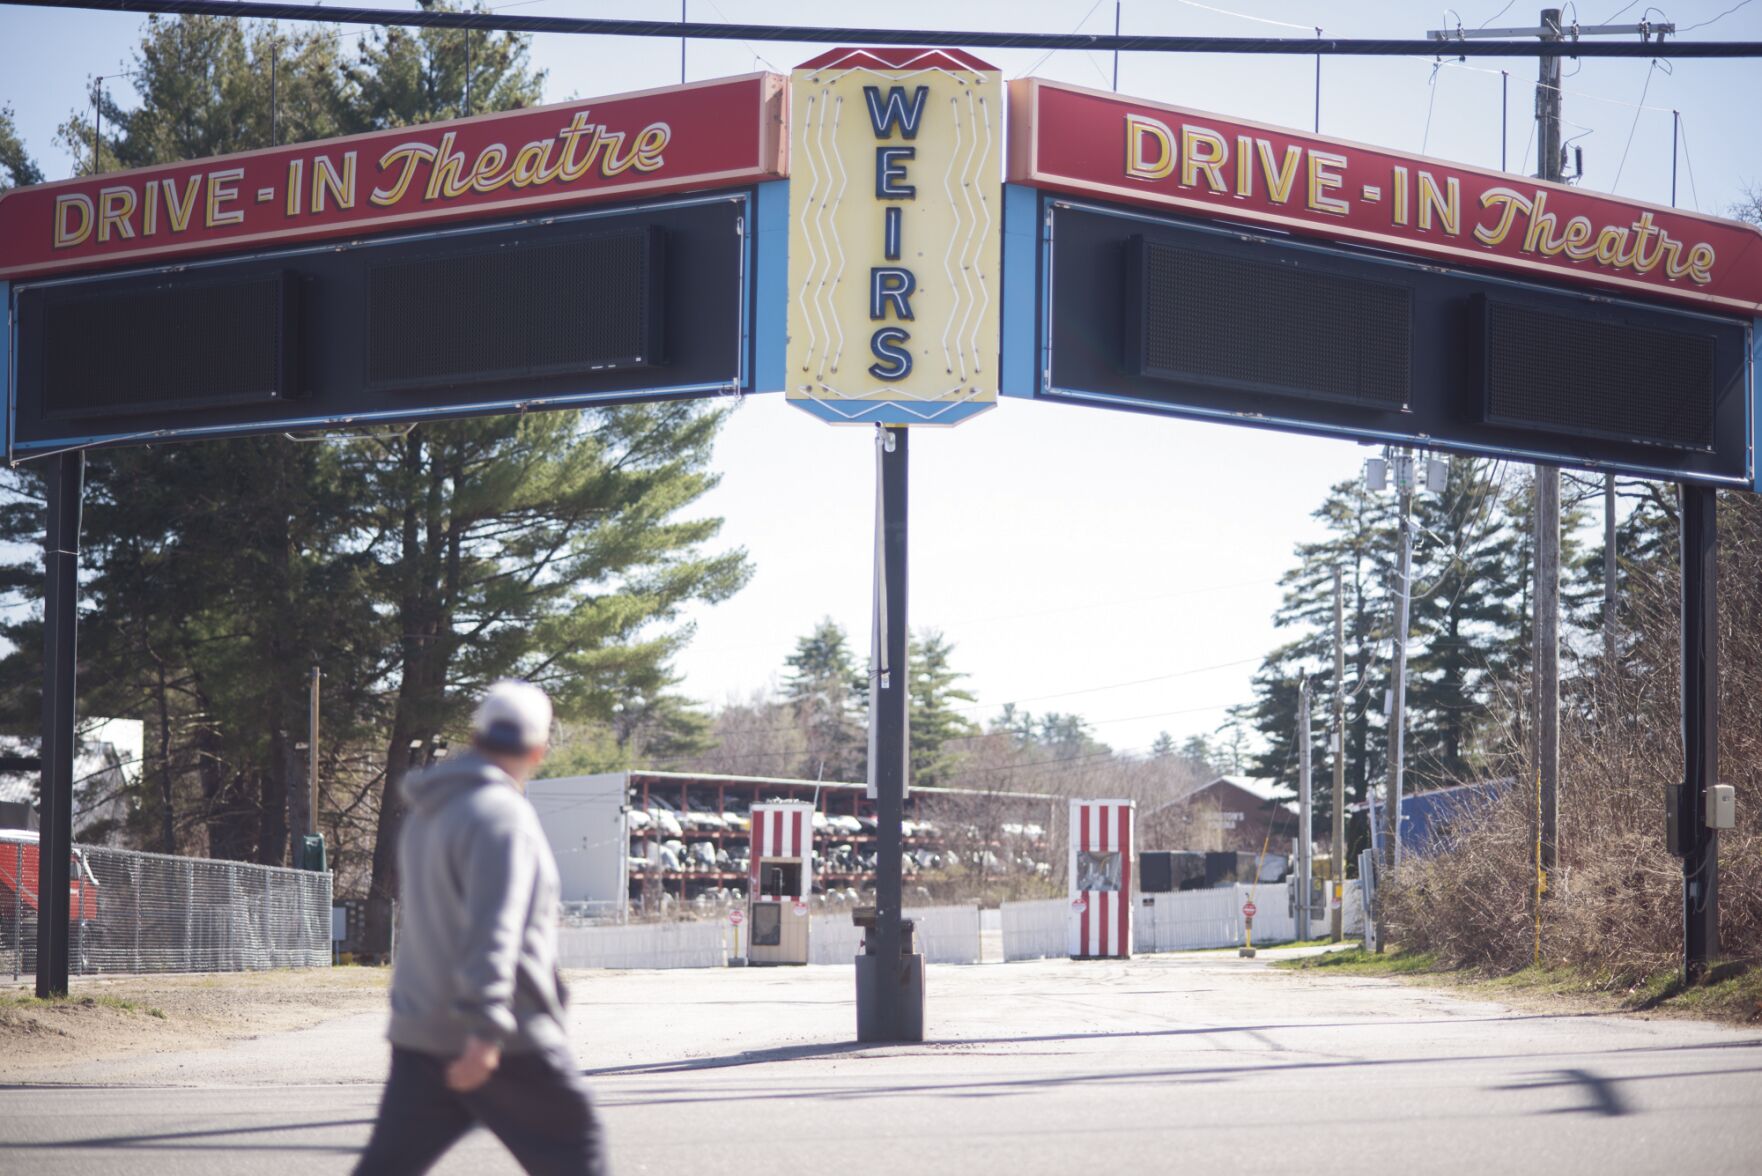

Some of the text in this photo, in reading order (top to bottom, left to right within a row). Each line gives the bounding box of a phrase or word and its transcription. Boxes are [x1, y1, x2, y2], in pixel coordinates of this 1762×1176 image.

[370, 110, 672, 206] Theatre
[863, 85, 930, 382] WEIRS
[1473, 187, 1716, 284] Theatre
